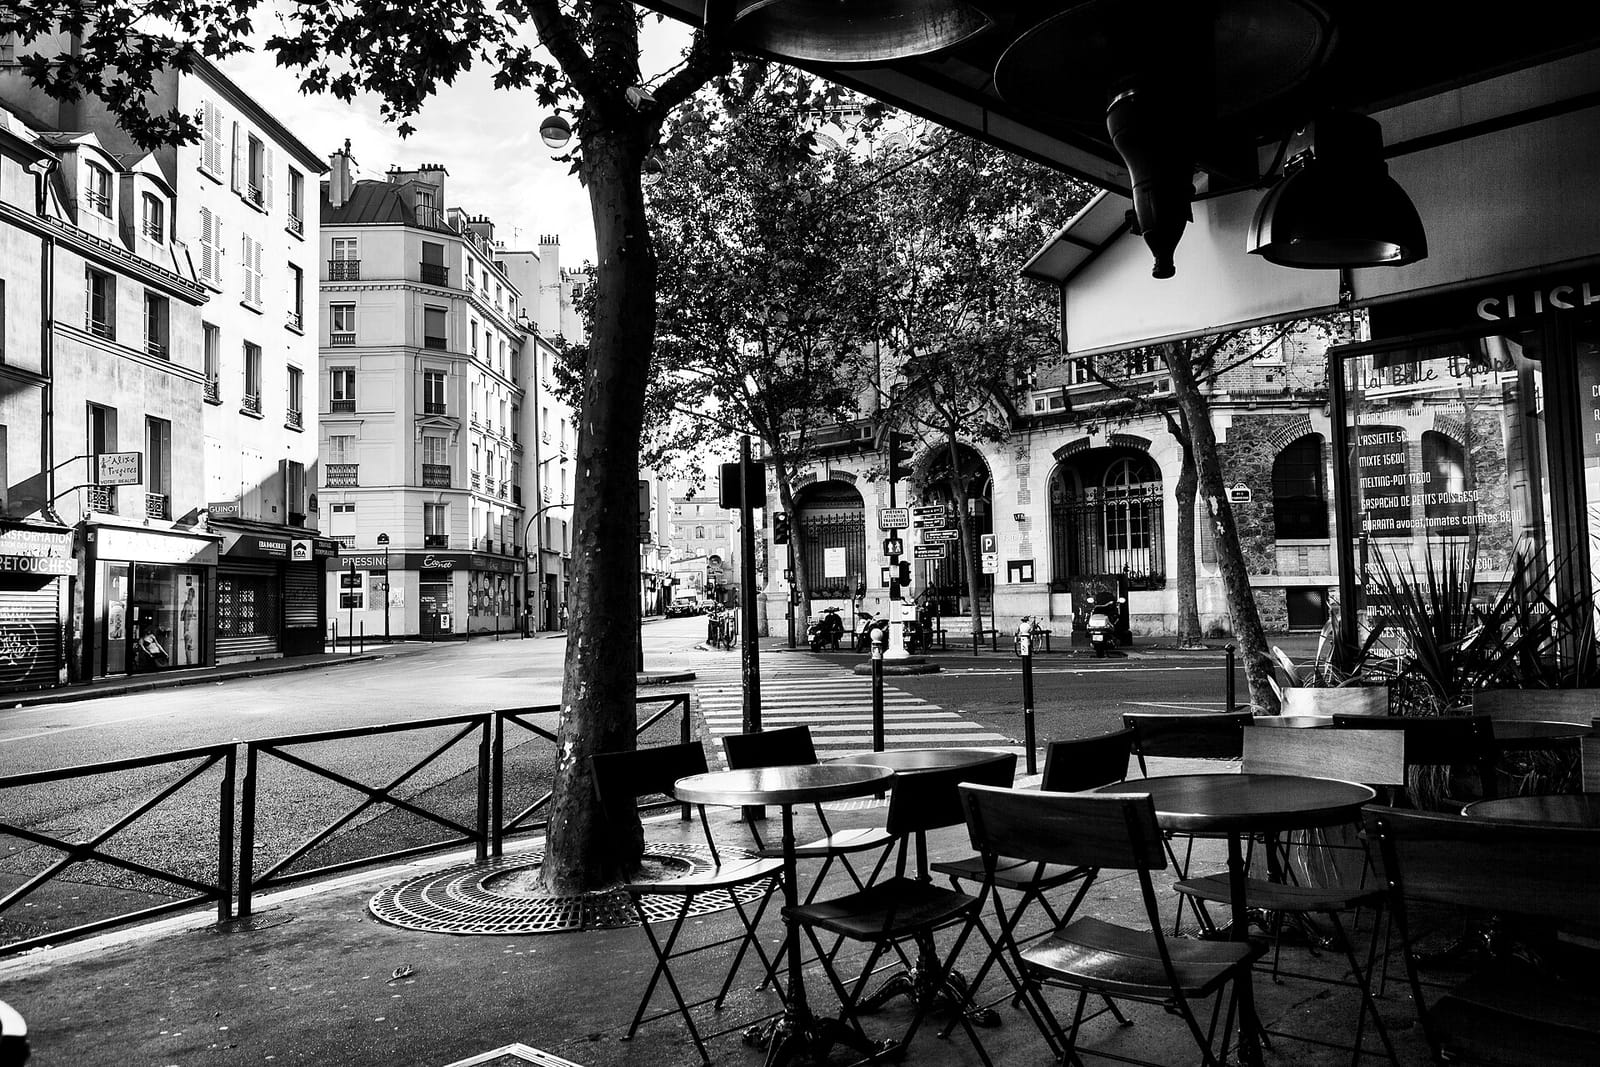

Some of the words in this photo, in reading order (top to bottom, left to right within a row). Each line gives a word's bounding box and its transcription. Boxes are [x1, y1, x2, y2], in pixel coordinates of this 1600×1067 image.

[1357, 431, 1395, 447] L'ASSIETTE
[1359, 454, 1381, 468] MIXTE
[1382, 452, 1405, 465] 15€00
[1359, 473, 1407, 489] MELTING-POT
[1360, 496, 1399, 510] GASPACHO
[1400, 494, 1411, 507] DE
[1411, 492, 1437, 506] PETITS
[1438, 491, 1456, 505] POIS
[209, 505, 239, 513] GUINOT
[985, 538, 993, 551] P
